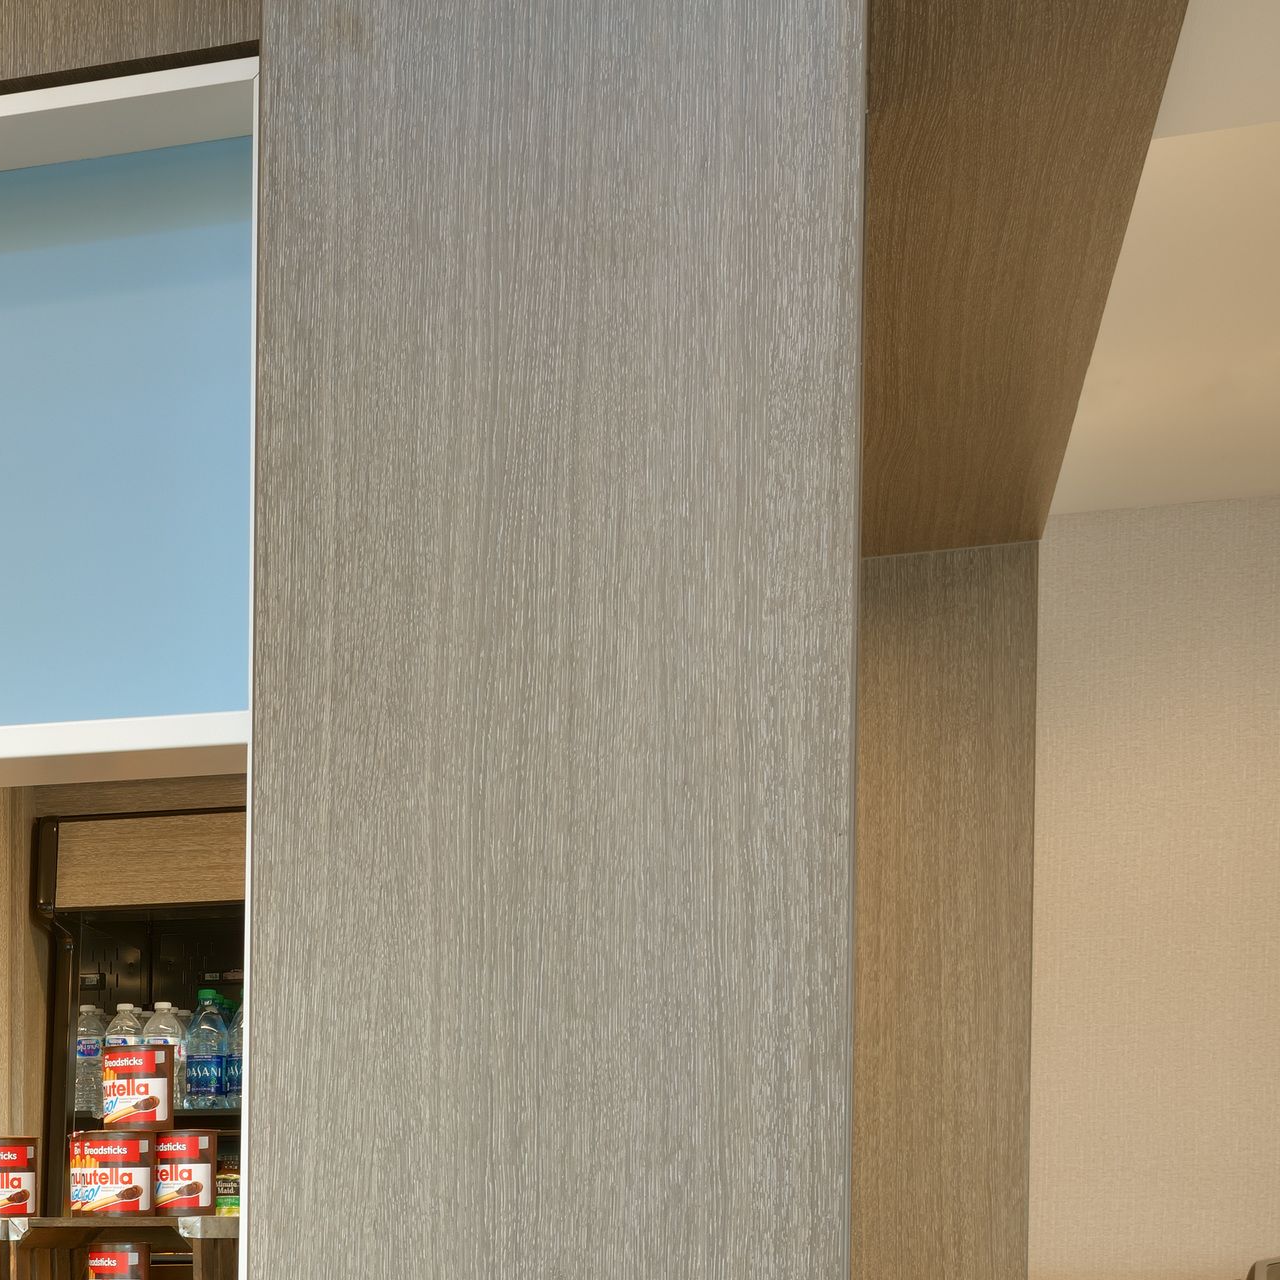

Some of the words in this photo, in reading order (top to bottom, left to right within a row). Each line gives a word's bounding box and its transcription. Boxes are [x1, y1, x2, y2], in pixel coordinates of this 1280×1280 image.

[104, 1056, 143, 1067] Breadsticks
[187, 1065, 222, 1078] DASANI
[103, 1078, 149, 1096] utella
[84, 1146, 128, 1155] Breadsticks
